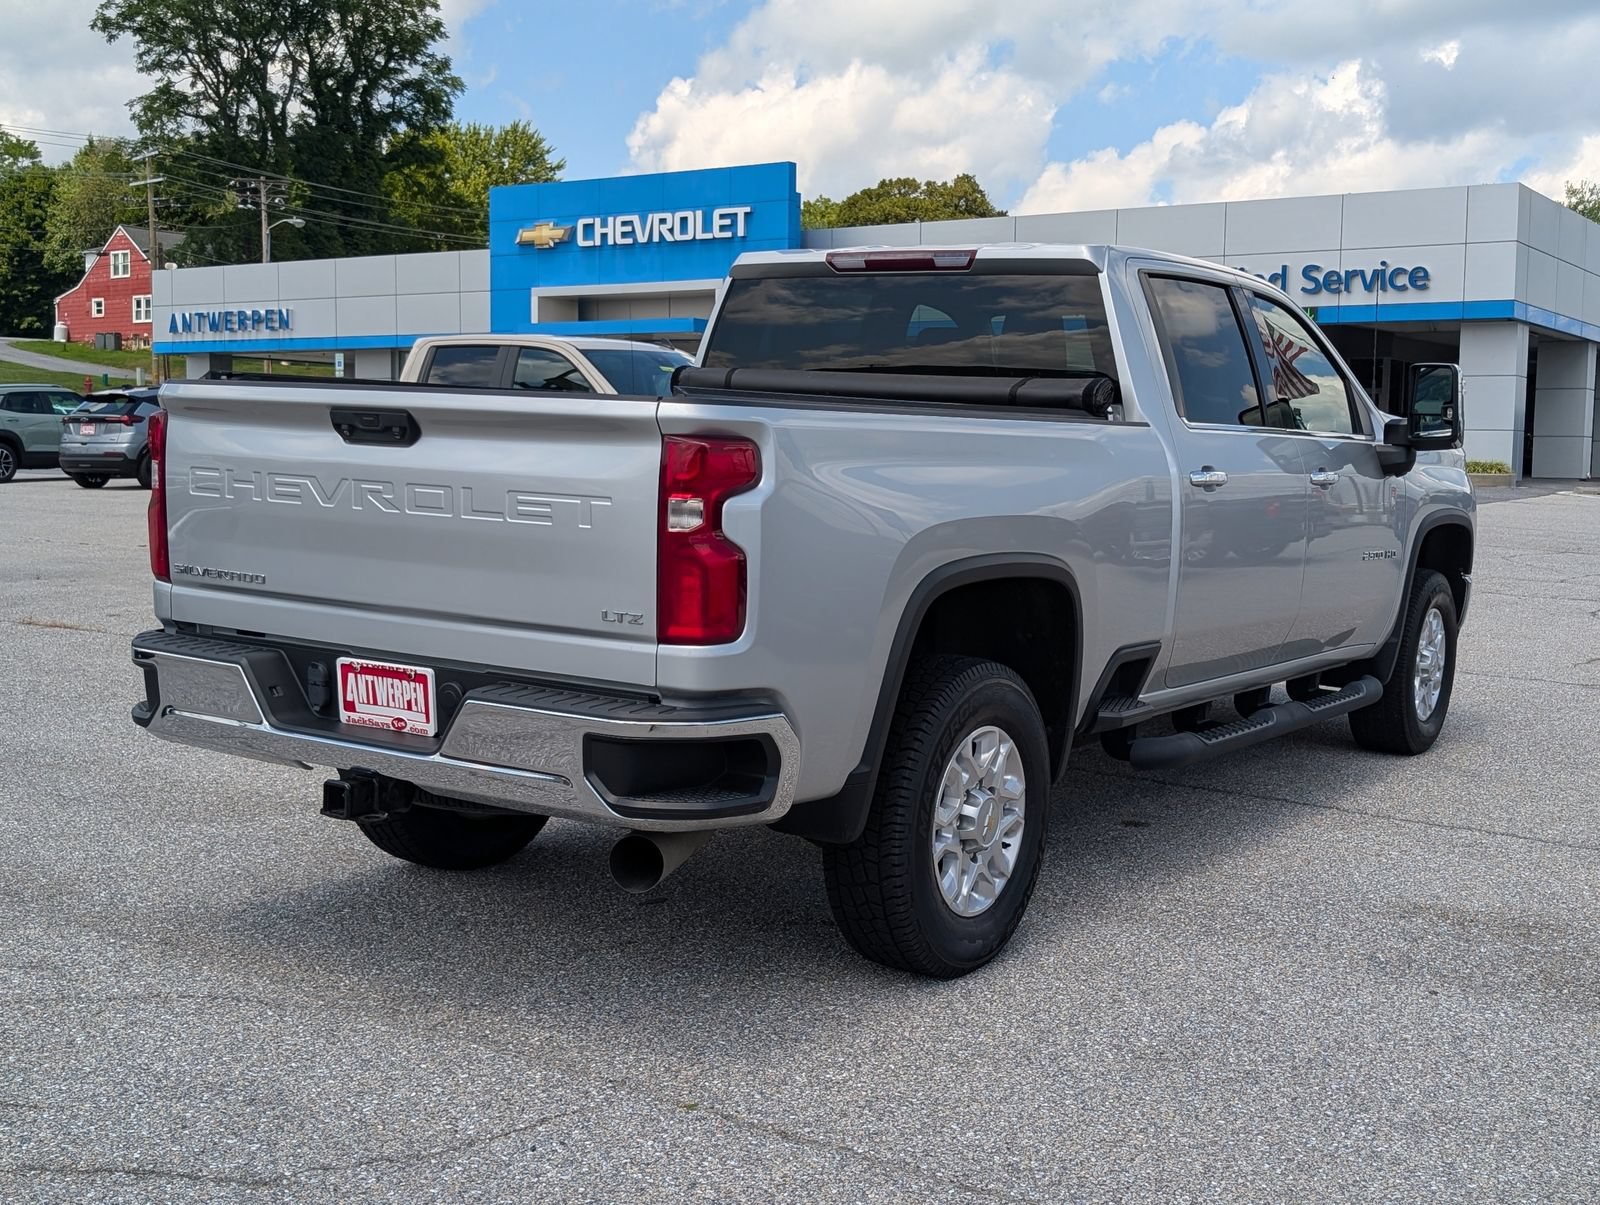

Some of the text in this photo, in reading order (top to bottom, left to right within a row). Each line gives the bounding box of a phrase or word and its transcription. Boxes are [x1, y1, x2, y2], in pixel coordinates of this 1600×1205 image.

[576, 206, 751, 248] CHEVROLET
[1300, 260, 1430, 295] Service
[169, 307, 292, 334] ANTWERPEN
[188, 465, 613, 530] CHEVROLET
[173, 563, 266, 585] SILVERADO
[600, 609, 644, 626] LTZ
[346, 672, 426, 713] ANTWERPEN
